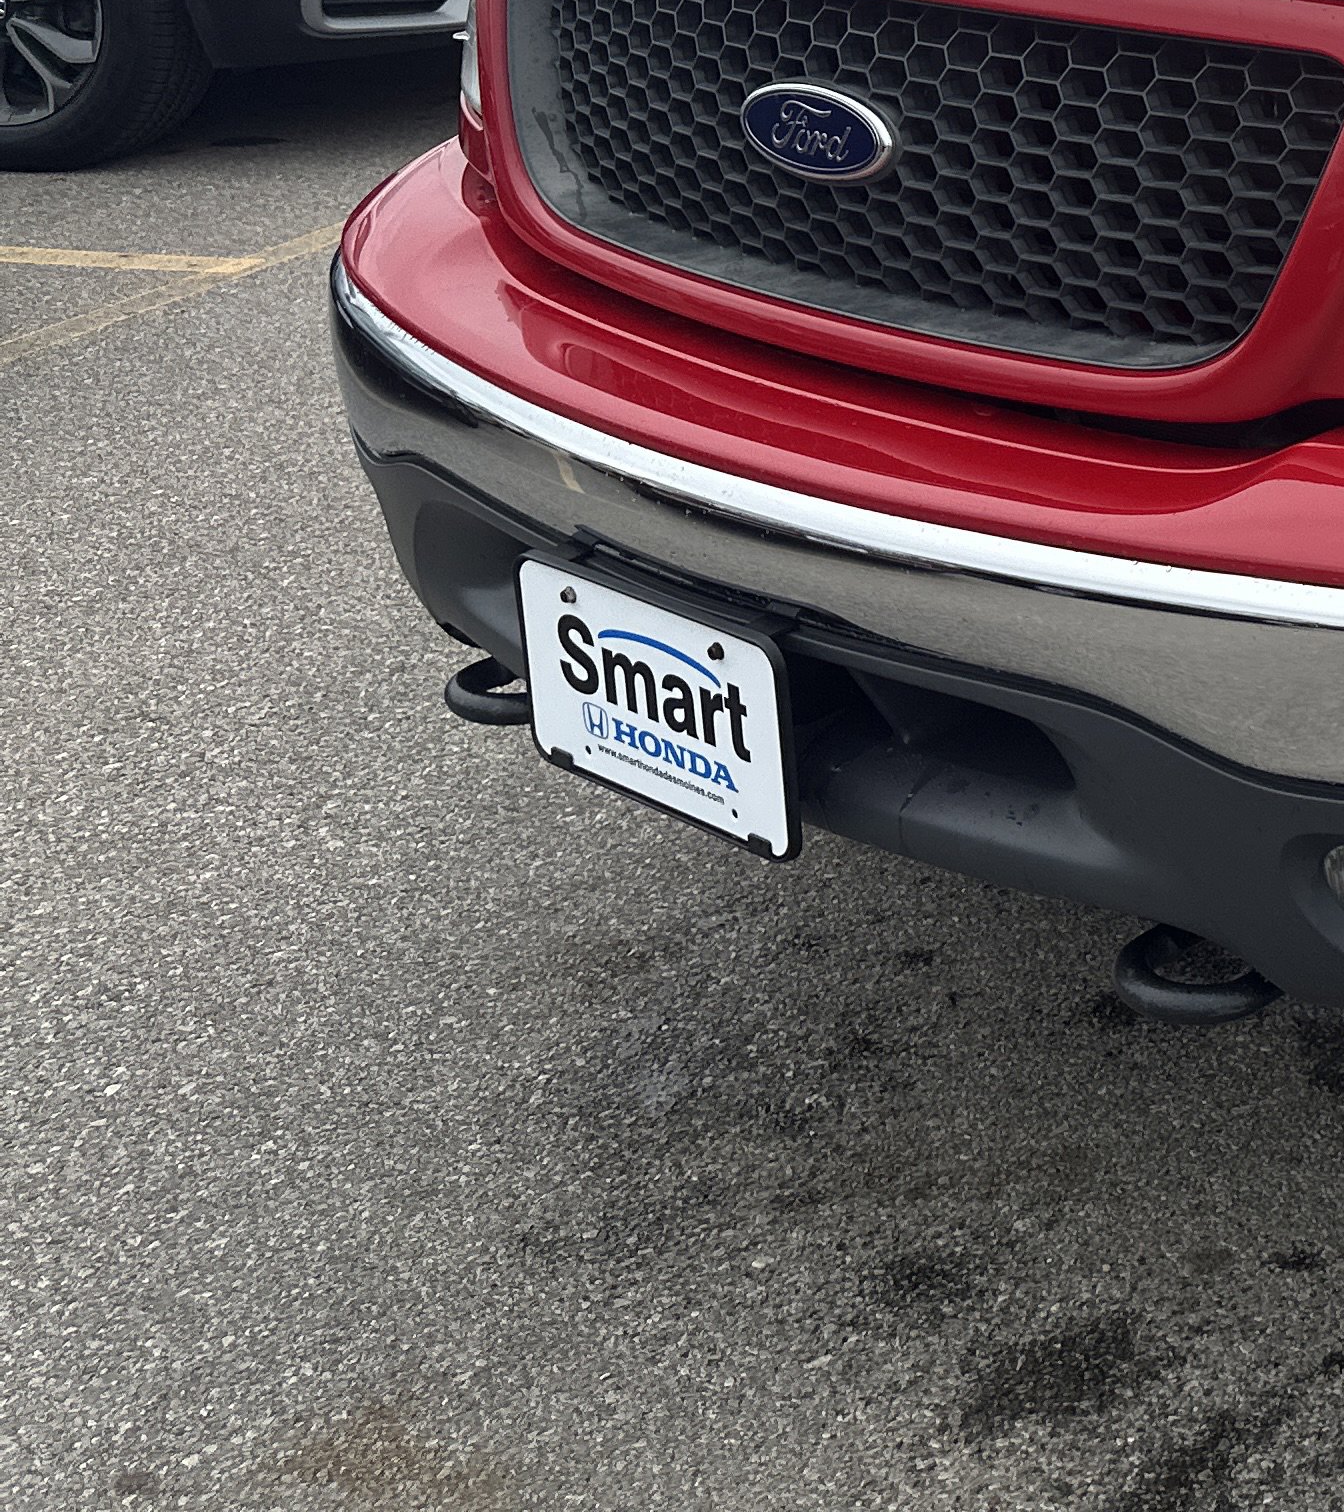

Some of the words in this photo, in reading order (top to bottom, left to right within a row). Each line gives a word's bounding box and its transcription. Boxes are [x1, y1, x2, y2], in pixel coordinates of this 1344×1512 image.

[771, 99, 852, 163] Ford
[557, 613, 752, 763] Smart
[611, 716, 739, 794] HONDA
